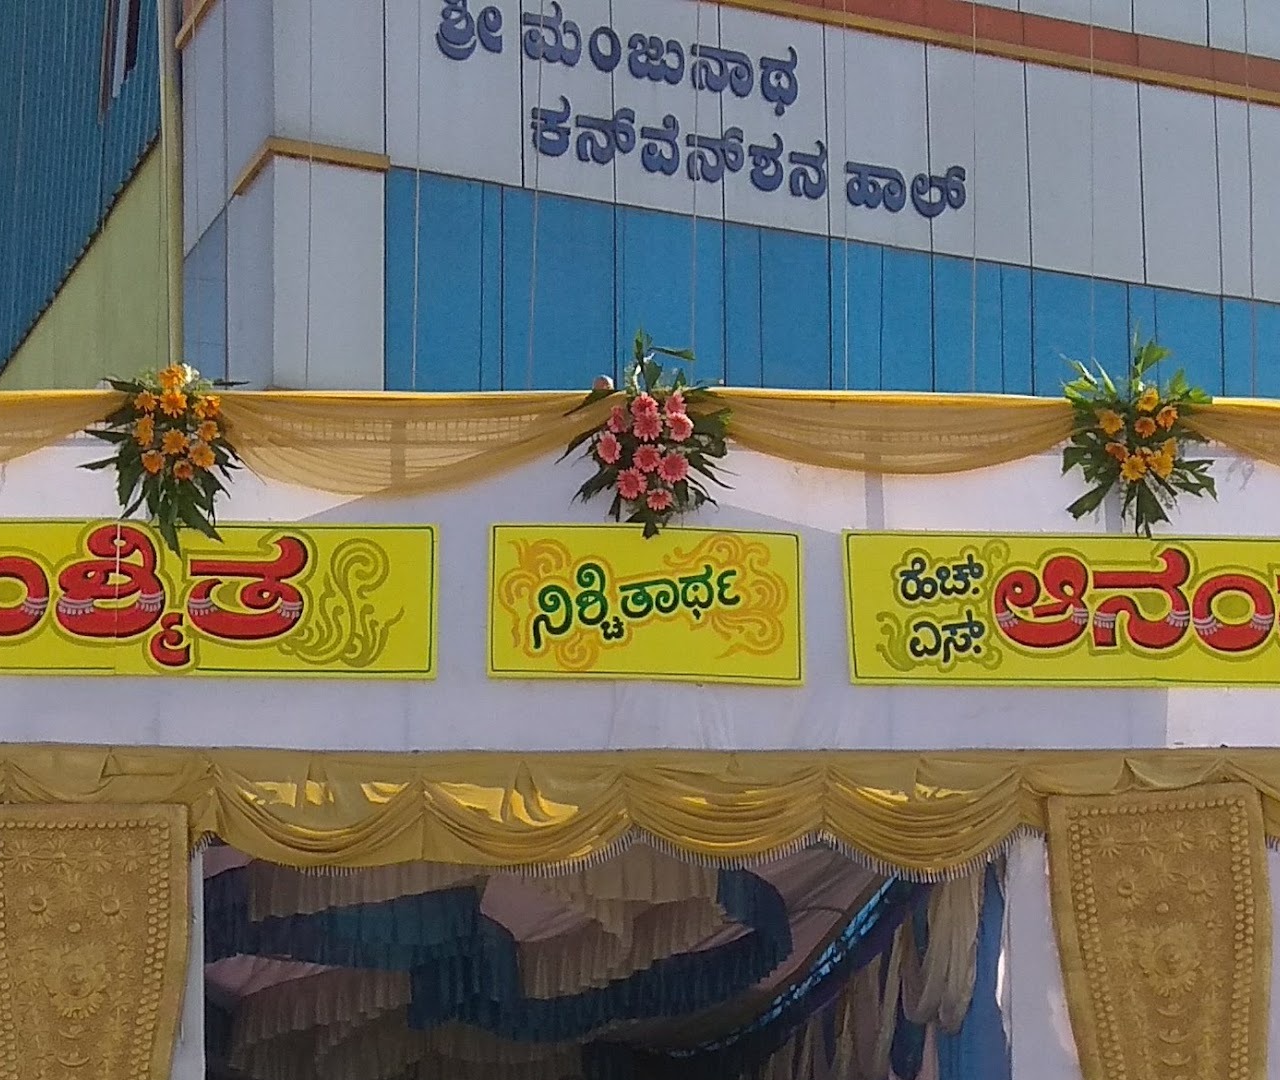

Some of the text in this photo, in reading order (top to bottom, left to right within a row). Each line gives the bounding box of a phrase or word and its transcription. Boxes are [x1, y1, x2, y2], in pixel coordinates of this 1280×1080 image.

[436, 0, 799, 116] ಶ್ರೀ ಮಂಜುನಾಥ
[845, 160, 967, 218] ಹಾಲ್
[532, 562, 741, 650] ನಿಶ್ಚಿತಾರ್ಥ
